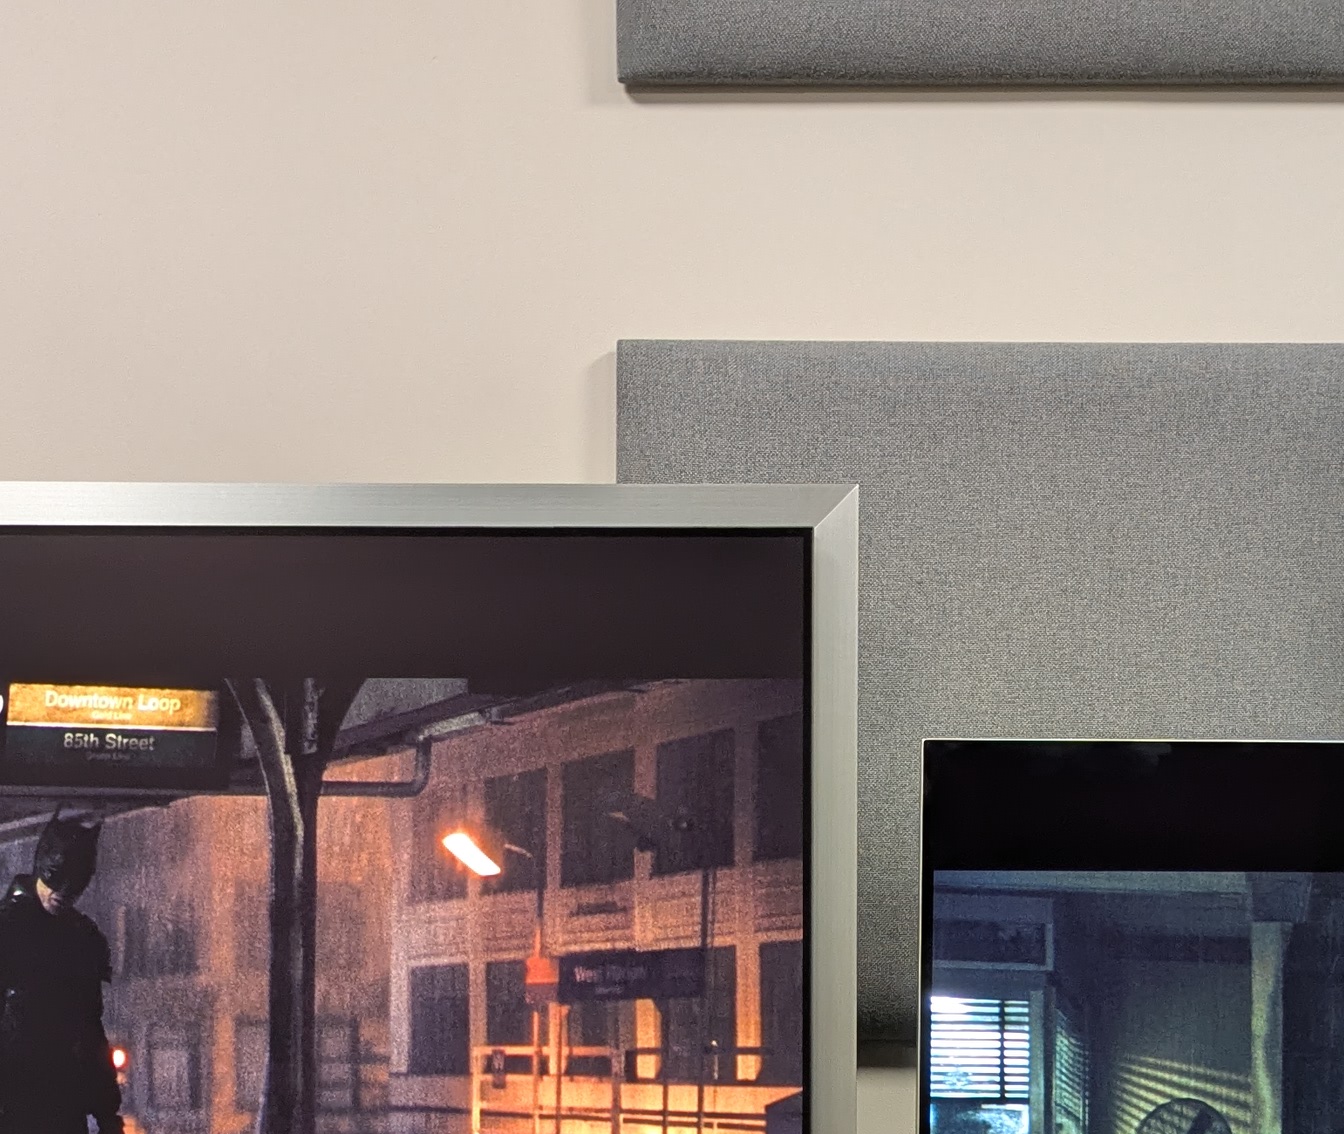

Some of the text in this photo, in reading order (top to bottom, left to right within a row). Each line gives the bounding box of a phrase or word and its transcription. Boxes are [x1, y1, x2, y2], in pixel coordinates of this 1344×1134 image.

[45, 690, 181, 715] Downtown Loop
[63, 732, 155, 751] 85th Street
